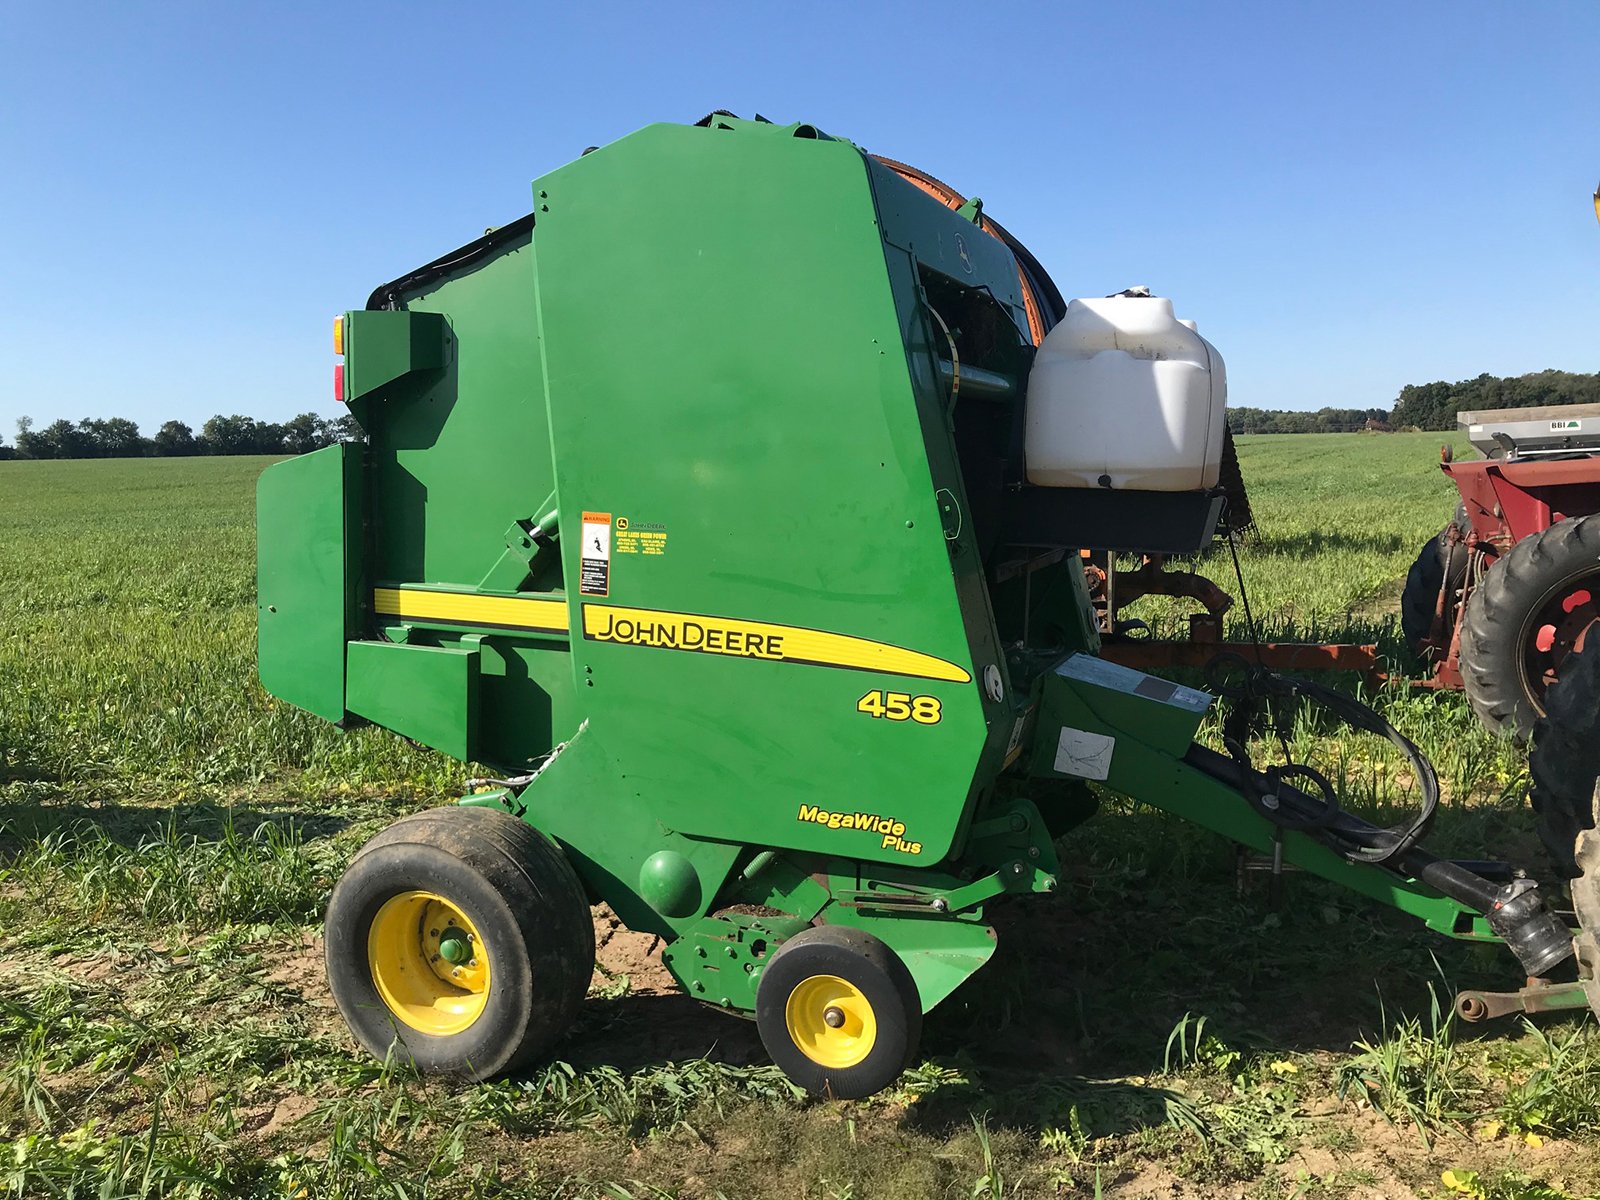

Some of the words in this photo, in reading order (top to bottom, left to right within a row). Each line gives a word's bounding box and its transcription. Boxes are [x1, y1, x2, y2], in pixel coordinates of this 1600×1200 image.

[1551, 421, 1566, 429] BBI
[598, 614, 676, 644] JOHN
[682, 621, 784, 656] DEERE
[857, 689, 942, 724] 458
[798, 804, 906, 836] MegaWide
[881, 834, 923, 854] Plus
